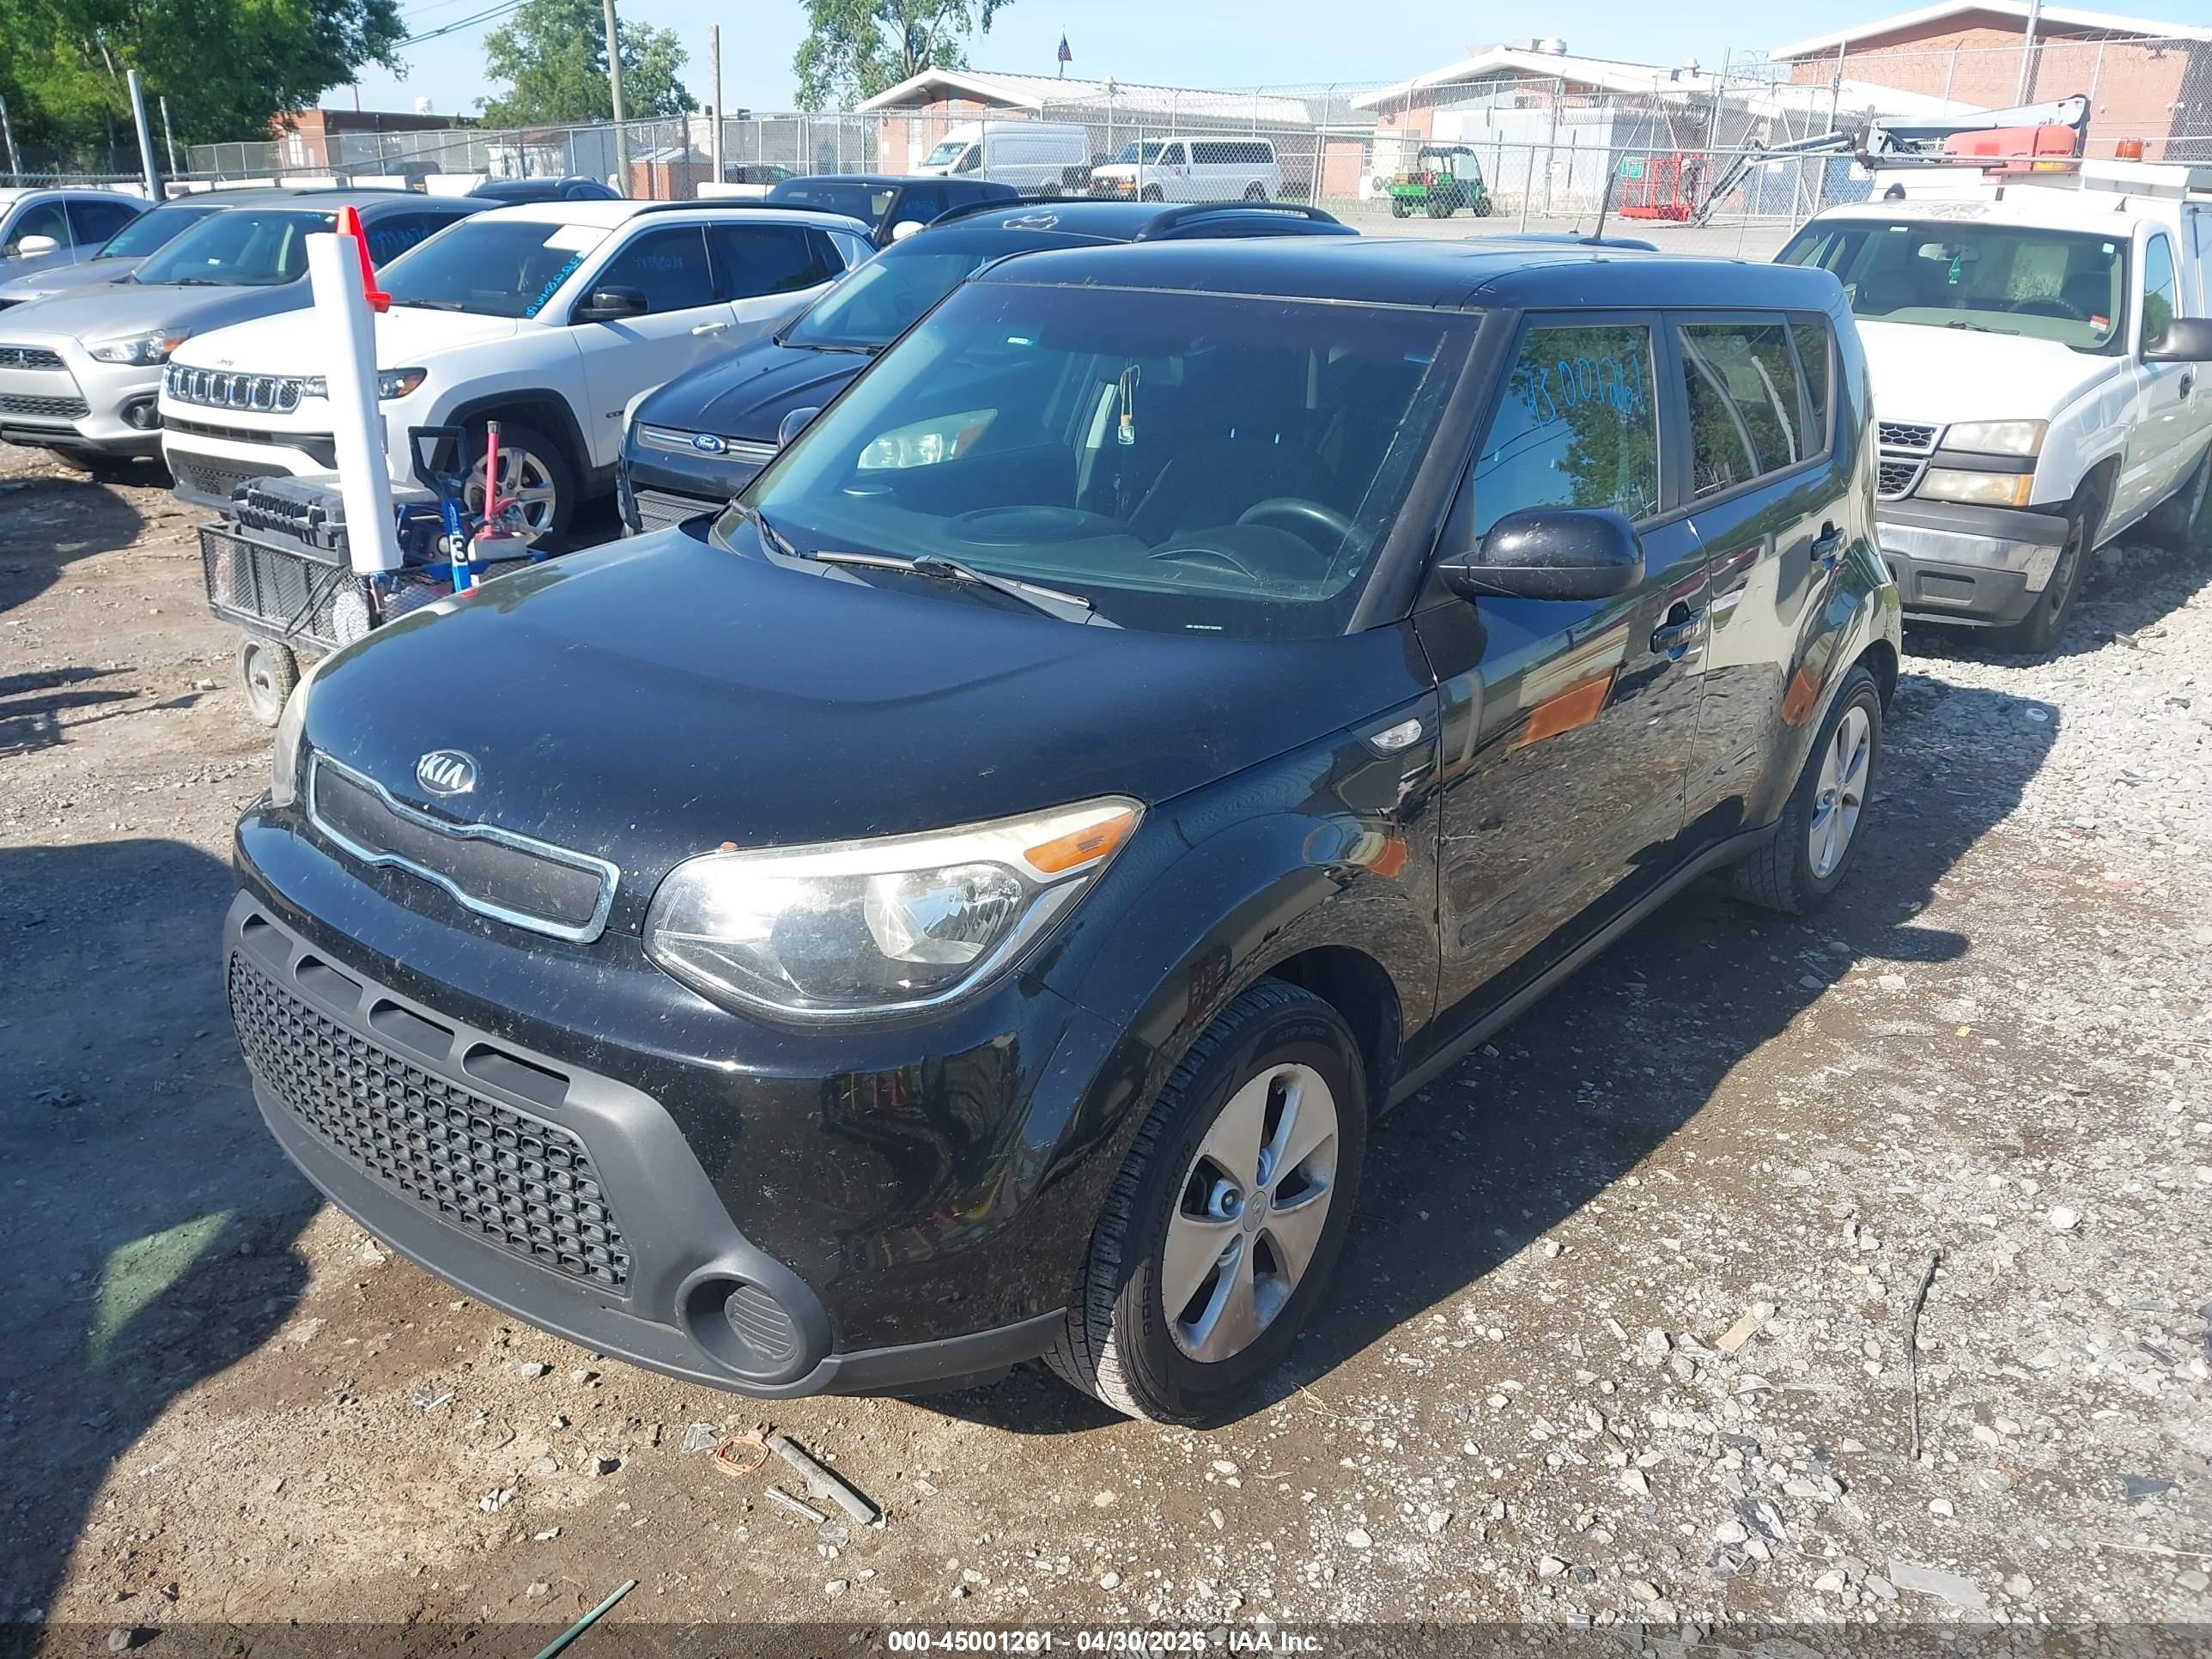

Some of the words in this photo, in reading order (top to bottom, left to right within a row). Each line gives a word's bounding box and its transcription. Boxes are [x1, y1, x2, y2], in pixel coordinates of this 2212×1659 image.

[696, 435, 716, 451] Ford
[452, 537, 468, 563] 3
[420, 753, 466, 790] KIA
